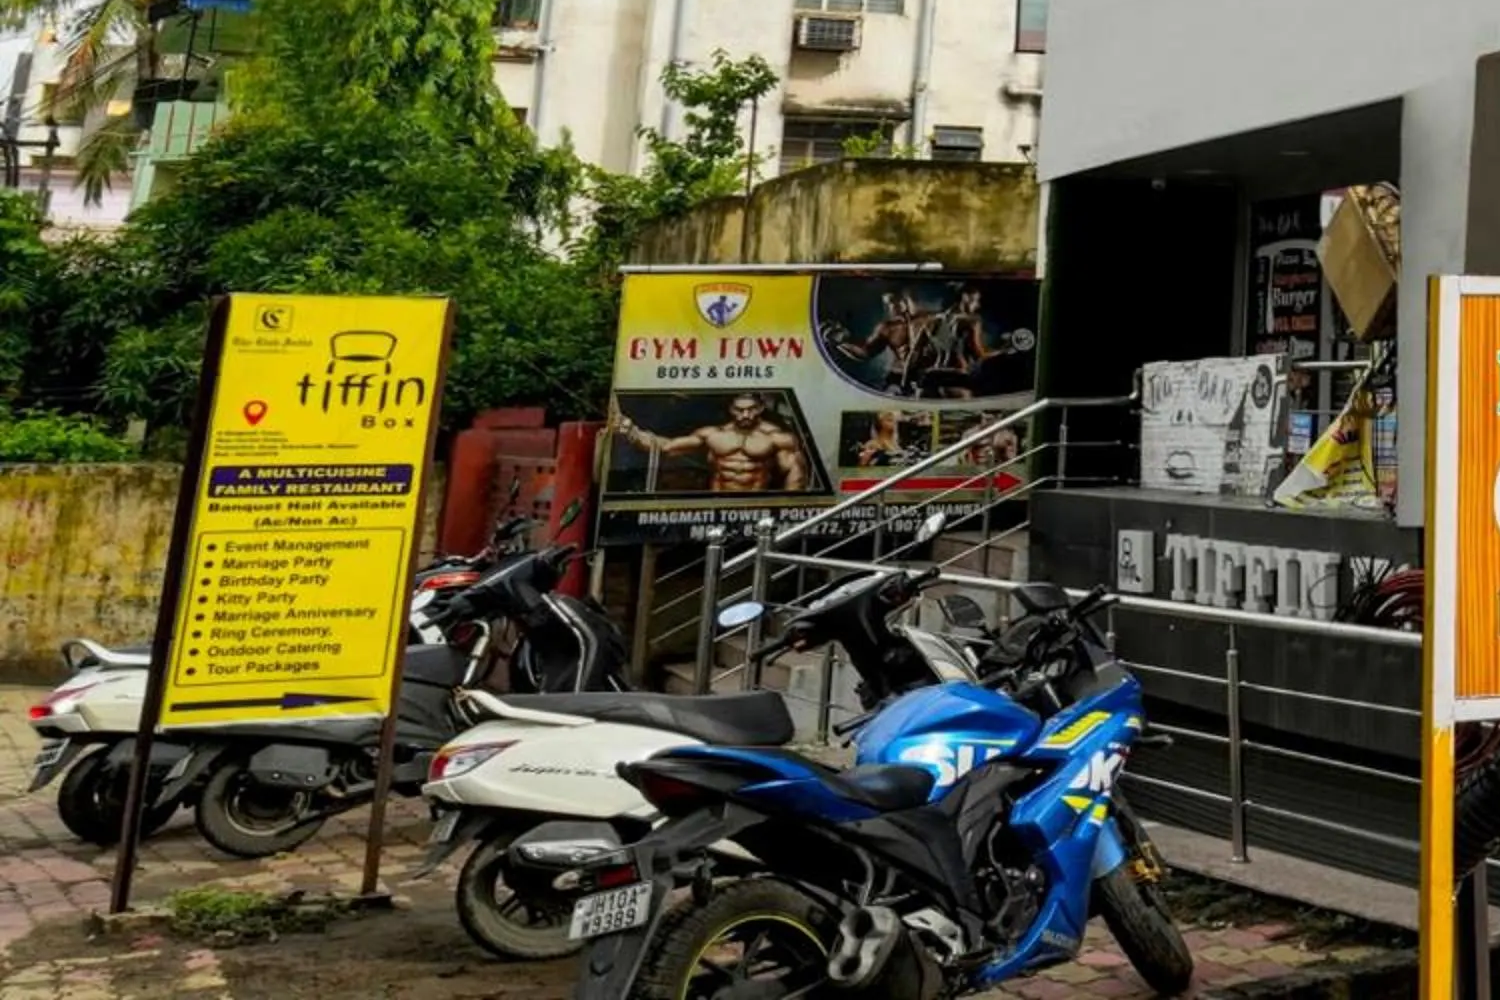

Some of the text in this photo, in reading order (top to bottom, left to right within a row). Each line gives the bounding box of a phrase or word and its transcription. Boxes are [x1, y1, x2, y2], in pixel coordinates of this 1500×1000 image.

[628, 336, 804, 361] GYM TOWN
[656, 365, 775, 379] BOYS & GIRLS
[297, 364, 425, 414] tiffin
[361, 415, 415, 430] Box
[238, 467, 387, 479] A MULTICUISINE
[214, 482, 406, 496] FAMILY RESTAURANT
[208, 500, 406, 514] Banquet Hall Available
[638, 511, 715, 525] BHAGMATI
[224, 539, 370, 553] Event Management
[221, 556, 334, 571] Marriage Party
[218, 573, 329, 589] Birthday Party
[216, 592, 298, 606] Kitty Party
[213, 607, 377, 624] Marriage Anniversary
[210, 627, 246, 642] Ring
[207, 642, 342, 658] Outdoor Catering
[207, 661, 320, 675] Tour Packages
